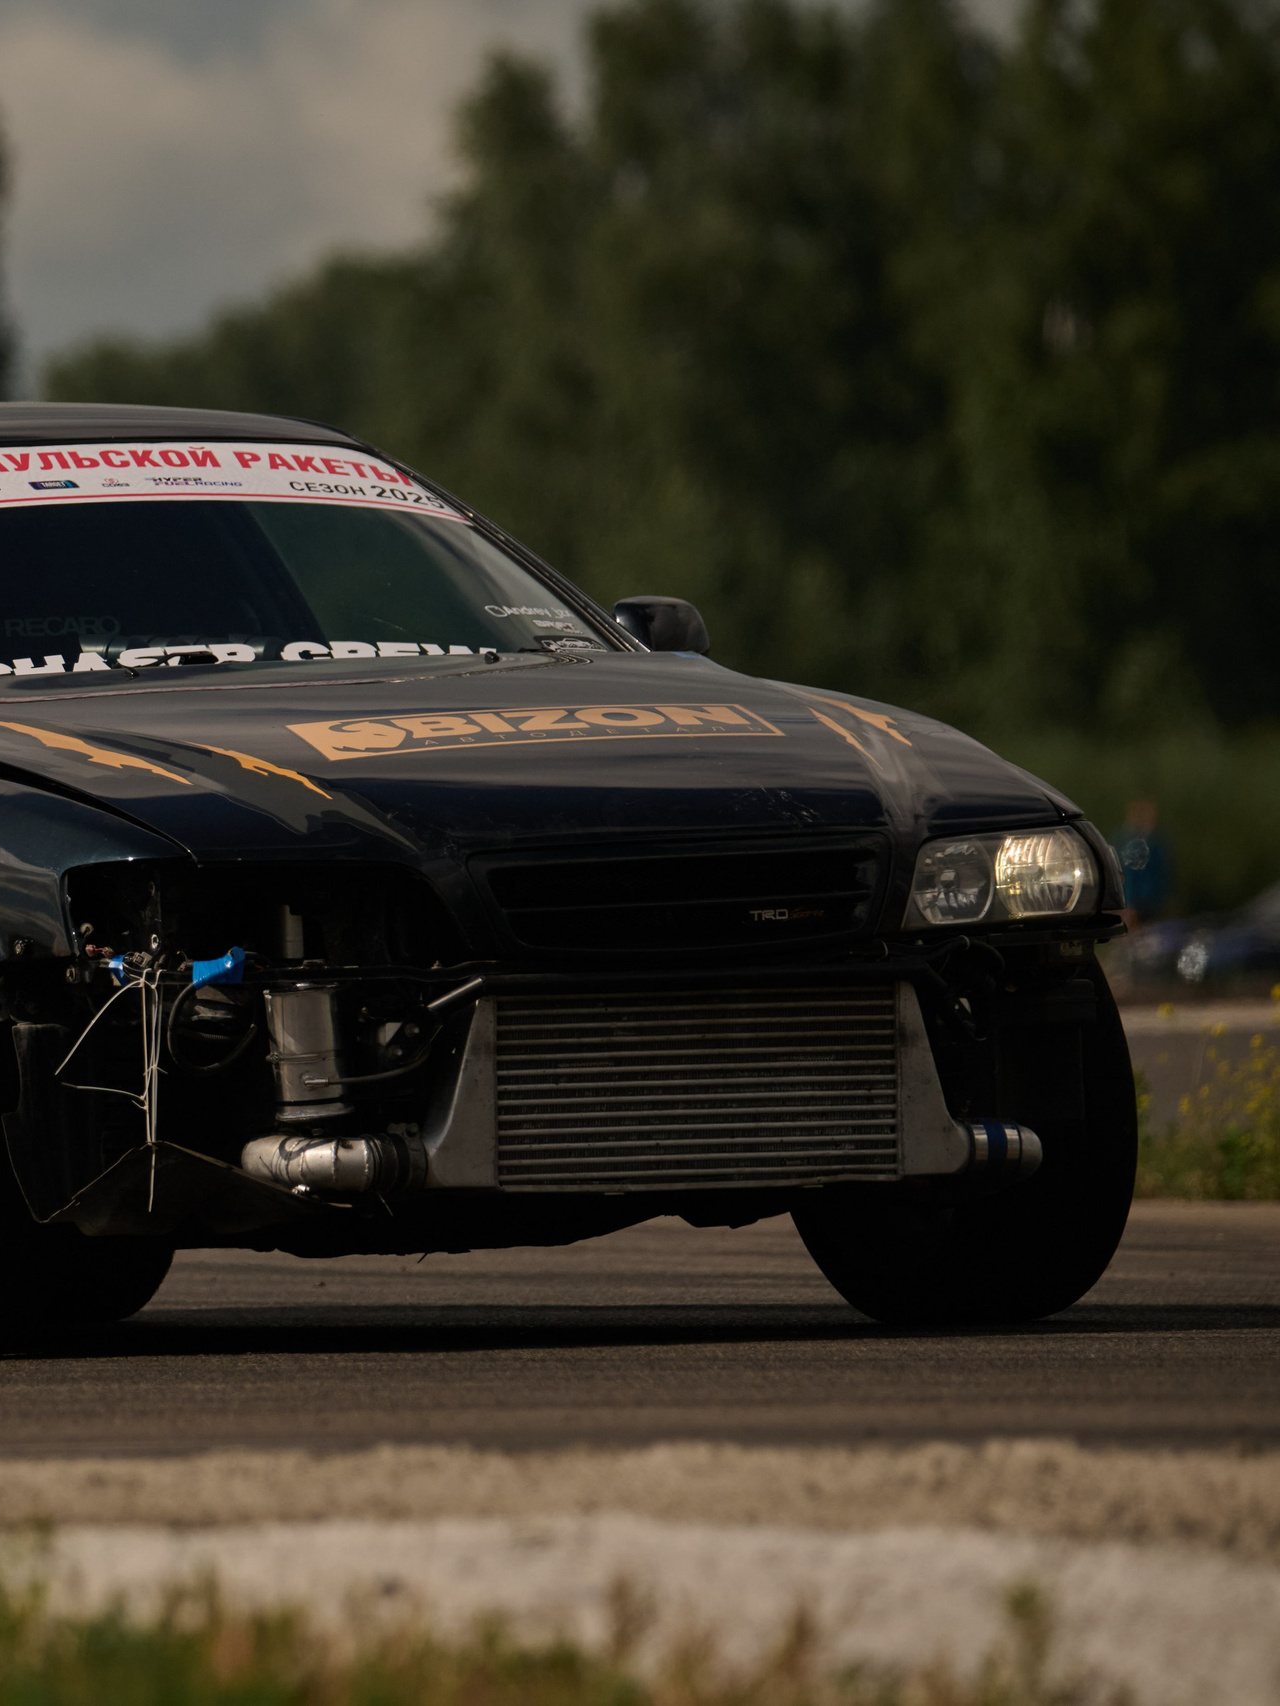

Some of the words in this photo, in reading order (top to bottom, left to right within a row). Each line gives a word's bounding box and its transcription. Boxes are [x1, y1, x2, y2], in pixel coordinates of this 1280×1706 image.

[233, 451, 415, 488] РАКЕТЫ
[289, 481, 367, 496] СЕЗОН
[370, 485, 446, 510] 2025
[4, 616, 121, 637] RECARO
[394, 705, 752, 739] BIZON
[424, 725, 762, 747] АВТОДЕТАЛЬ
[748, 908, 789, 922] TRD
